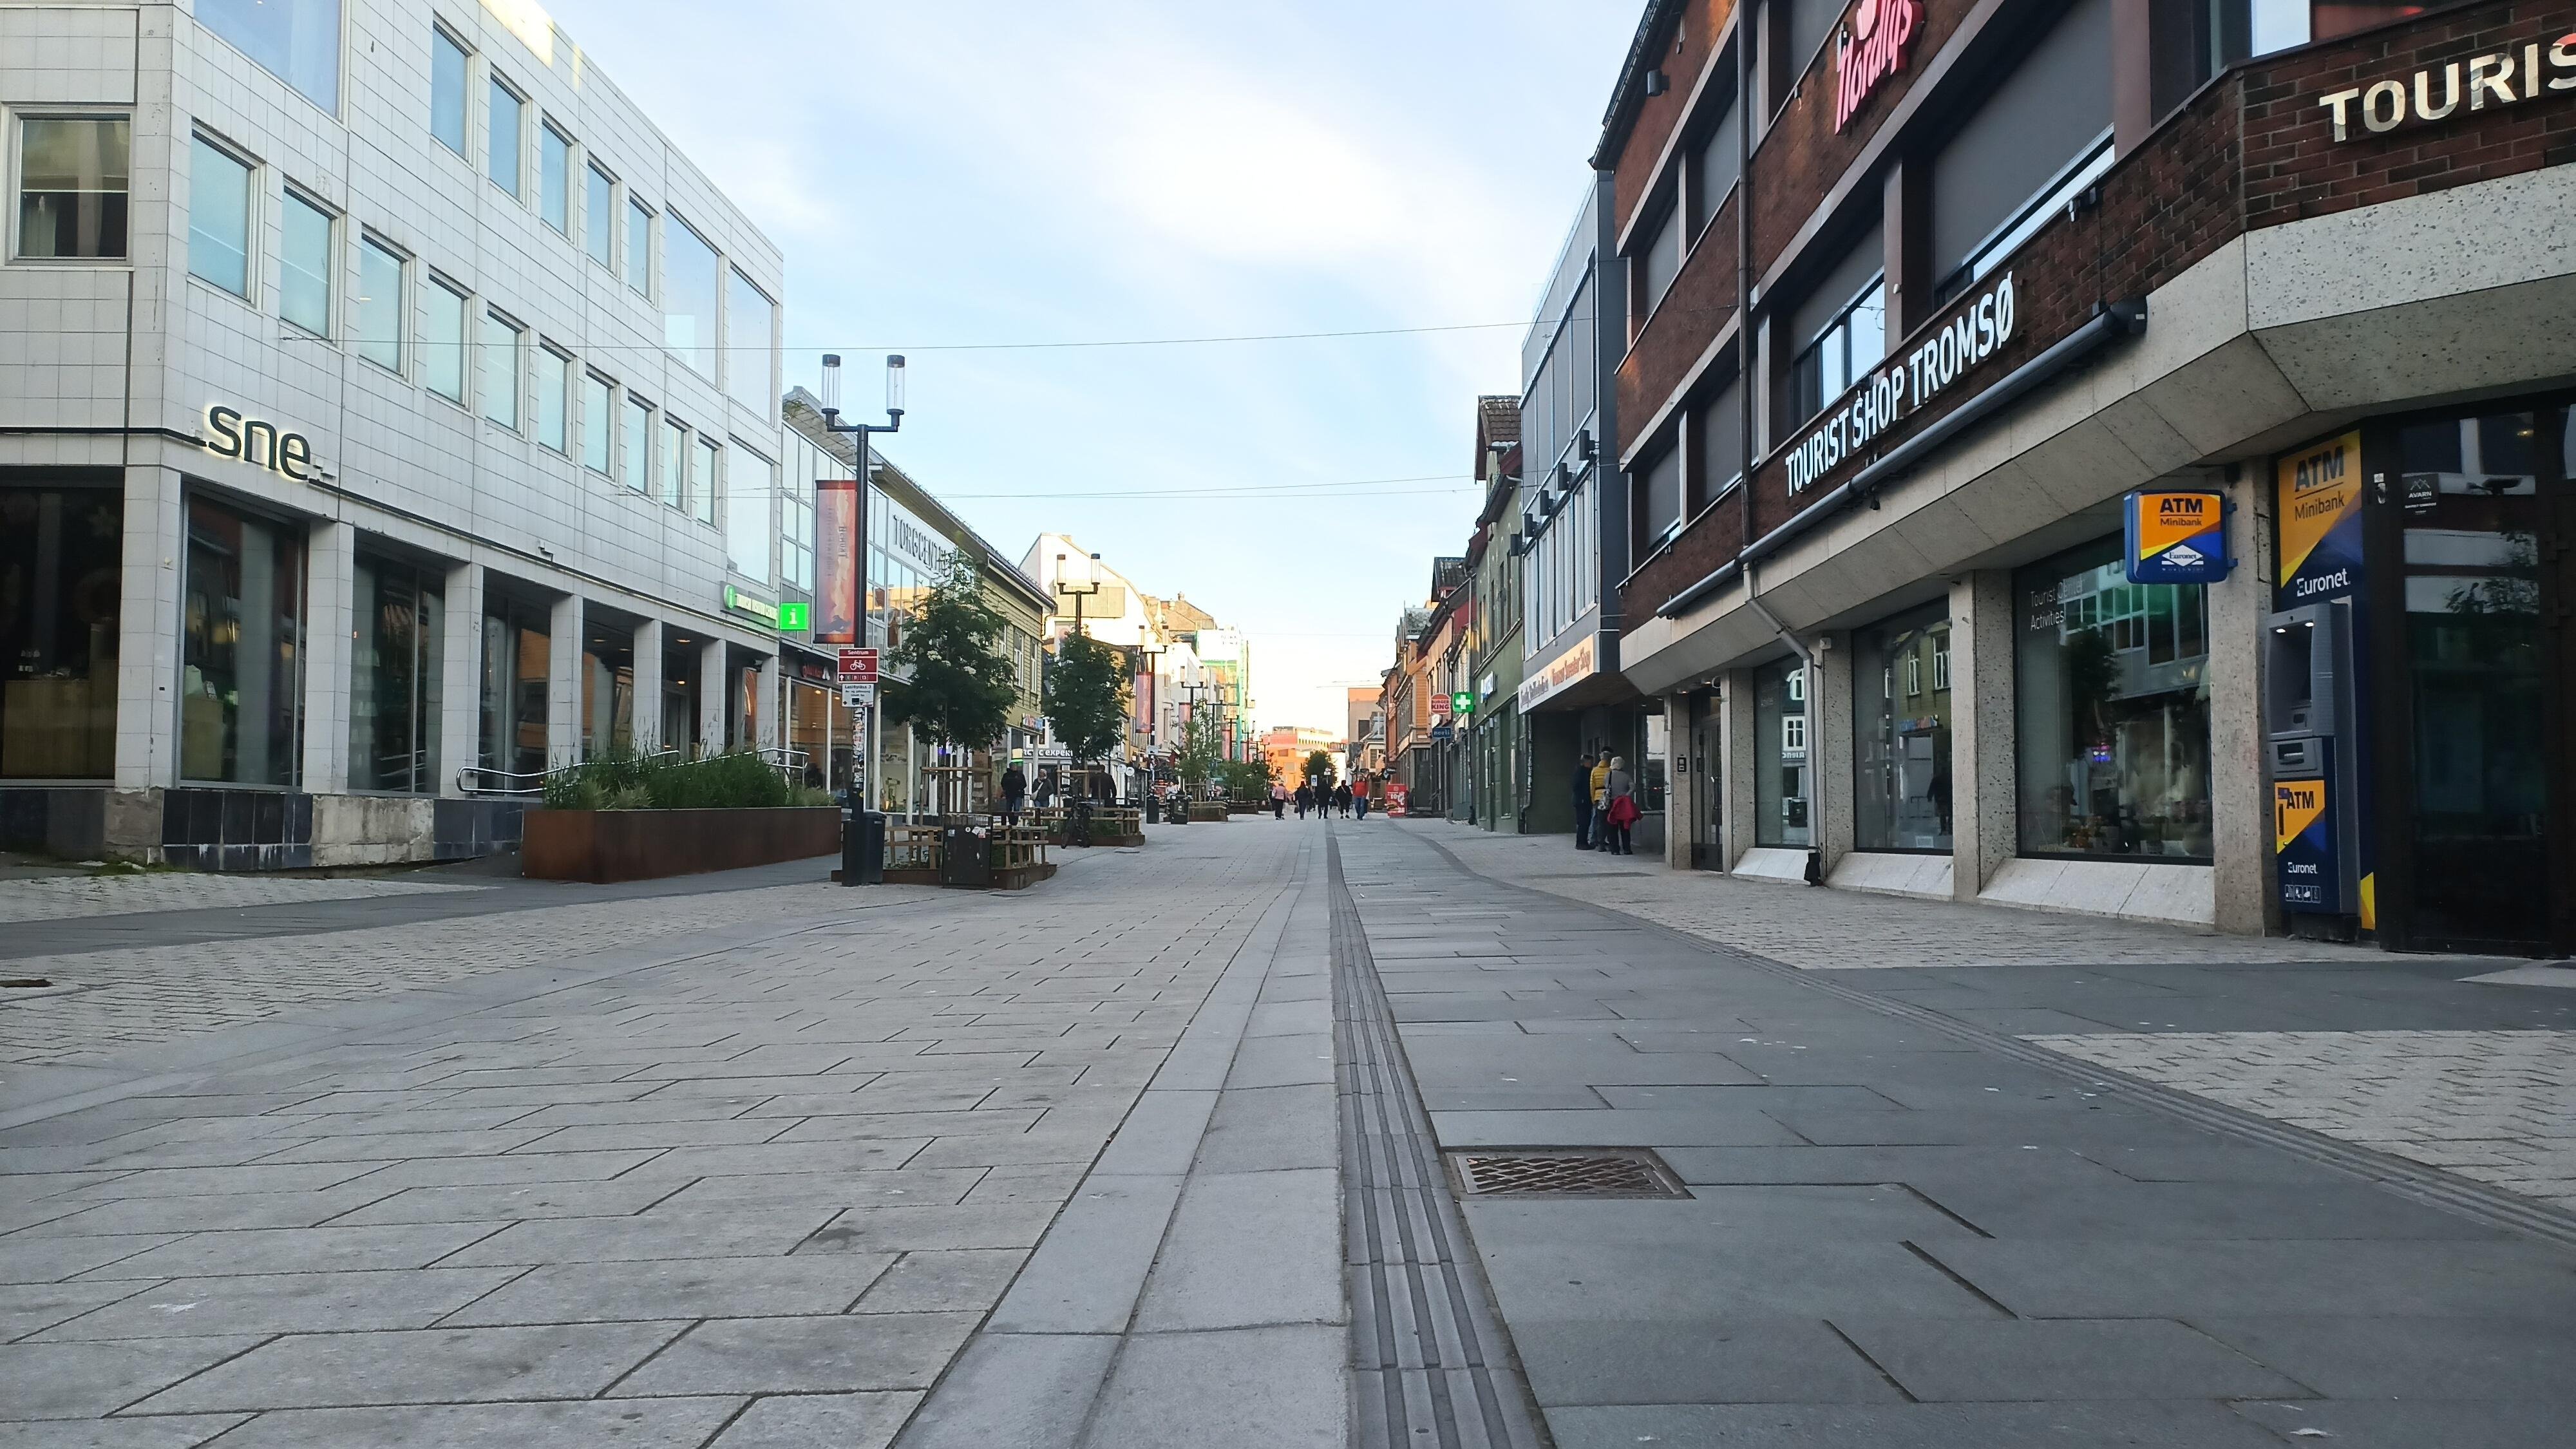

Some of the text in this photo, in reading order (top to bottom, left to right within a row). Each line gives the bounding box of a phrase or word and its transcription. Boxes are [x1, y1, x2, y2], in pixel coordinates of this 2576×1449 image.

[1785, 271, 2014, 497] TOURIST SHOP TROMSØ
[208, 406, 311, 480] sne
[2295, 446, 2344, 493] ATM
[2160, 498, 2202, 513] ATM
[2295, 491, 2345, 522] Minibank
[2160, 518, 2202, 526] Minibank
[2297, 569, 2350, 597] Euronet
[2031, 588, 2056, 607] Tourist
[2031, 611, 2064, 631] Activities
[2286, 791, 2315, 810] ATM
[2288, 862, 2317, 874] Euronet
